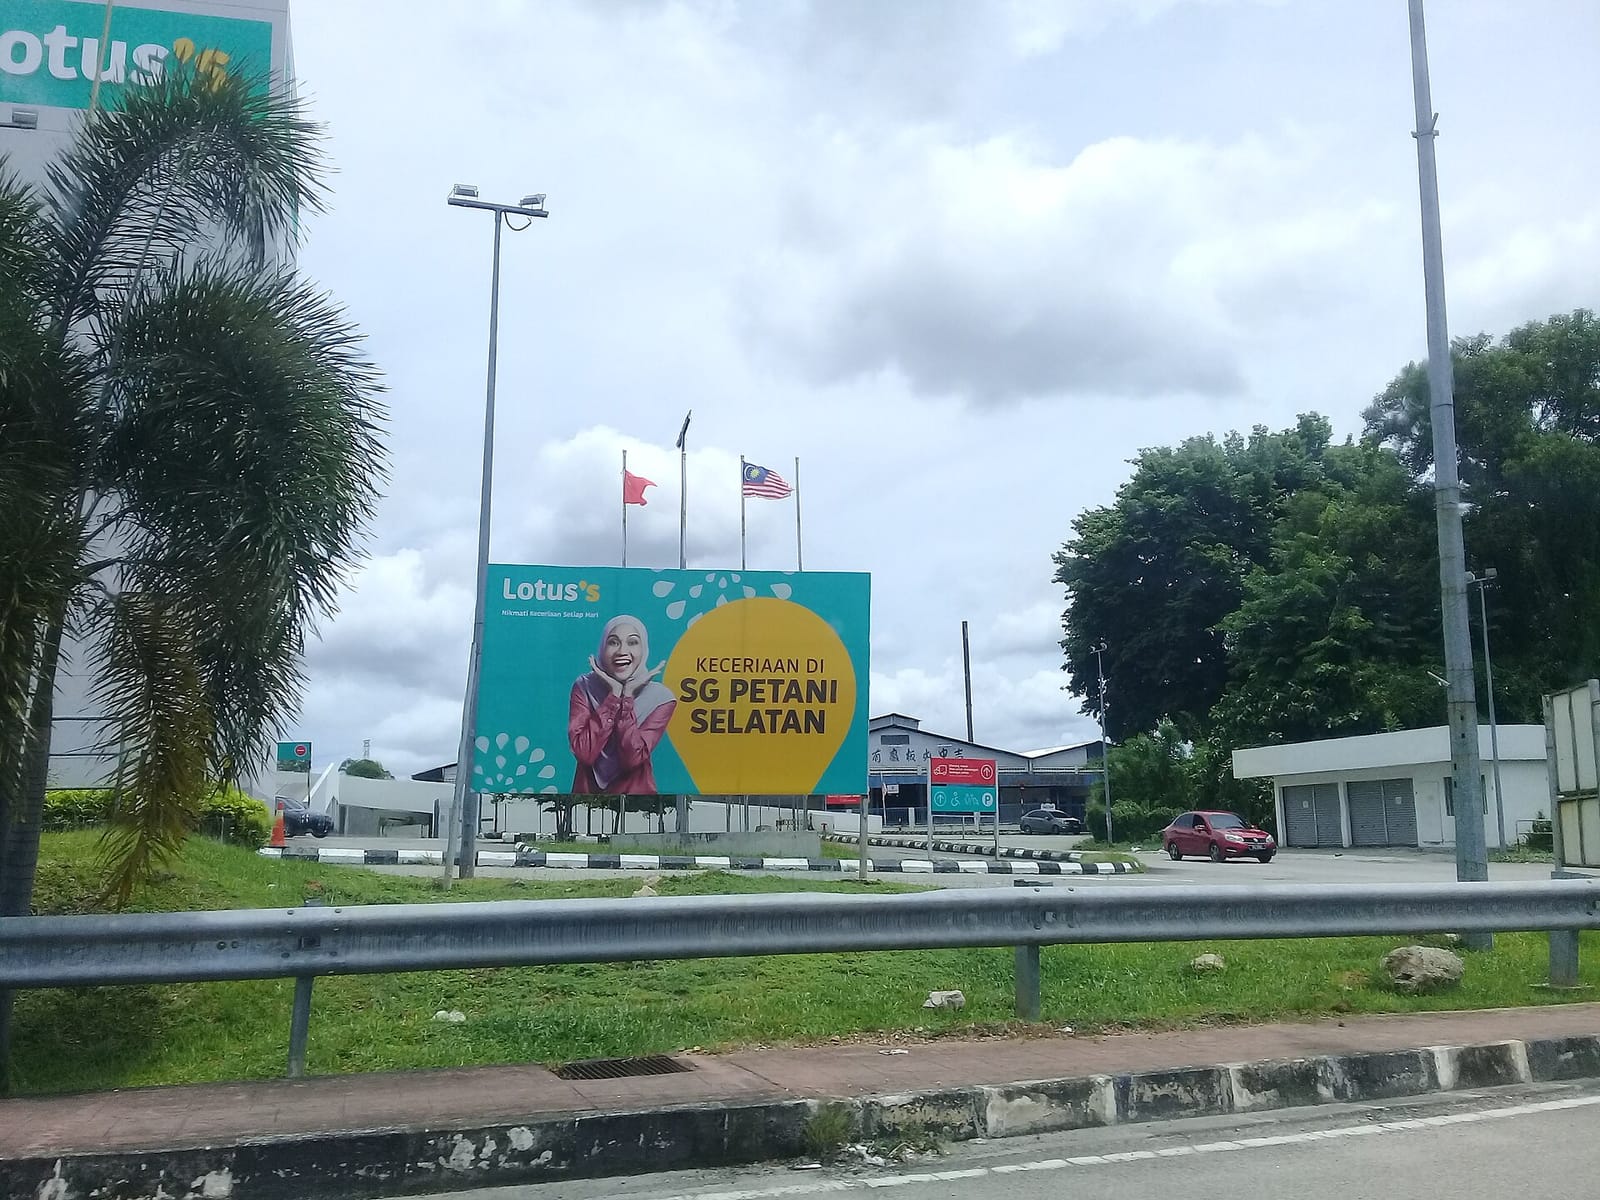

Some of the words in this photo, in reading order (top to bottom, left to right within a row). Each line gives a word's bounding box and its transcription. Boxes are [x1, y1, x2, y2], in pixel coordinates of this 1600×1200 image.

[503, 577, 600, 602] Lotus's
[562, 611, 584, 619] Setiap
[696, 657, 799, 673] KECERIAAN
[806, 658, 824, 673] DI
[680, 677, 720, 703] SG
[730, 678, 838, 704] PETANI
[690, 708, 826, 734] SELATAN
